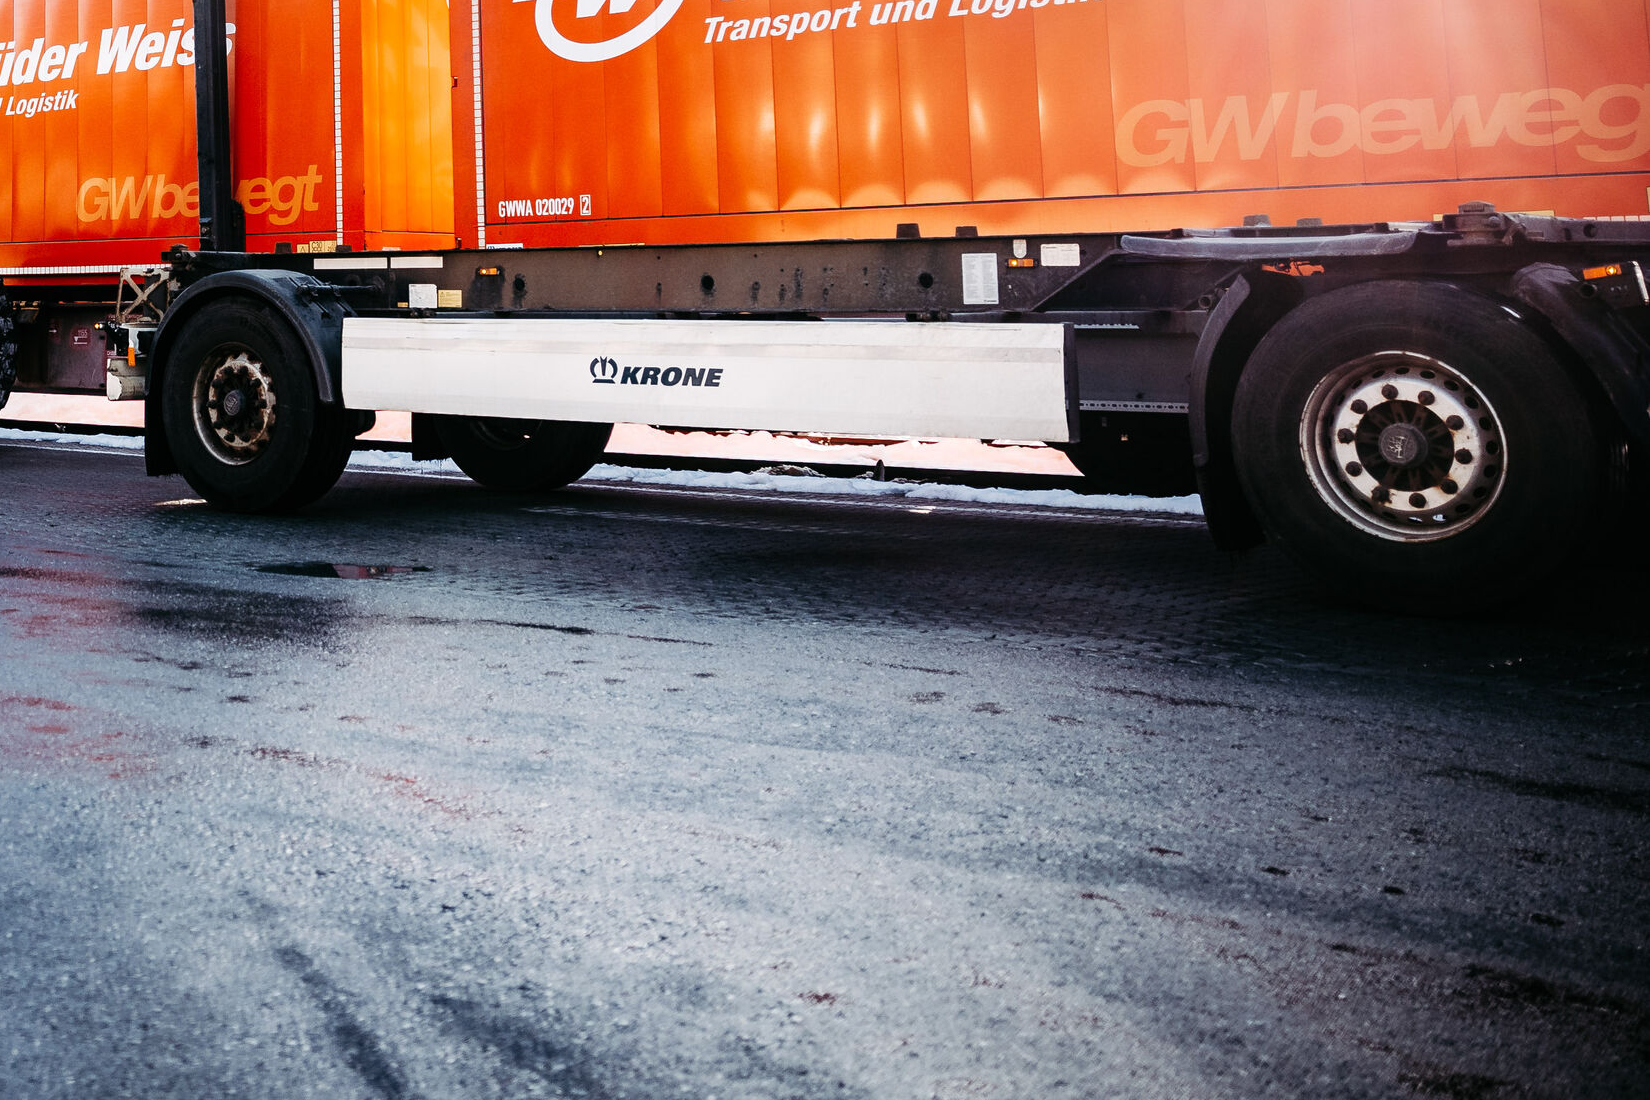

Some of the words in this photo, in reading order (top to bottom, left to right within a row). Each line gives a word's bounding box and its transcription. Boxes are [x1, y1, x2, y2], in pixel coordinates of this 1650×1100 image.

[704, 0, 861, 44] Transport
[6, 88, 80, 119] Logistik
[77, 164, 323, 226] GWbeegt
[498, 200, 534, 217] GWWA
[535, 197, 575, 216] 020029
[579, 194, 592, 216] 2
[620, 366, 724, 387] KRONE
